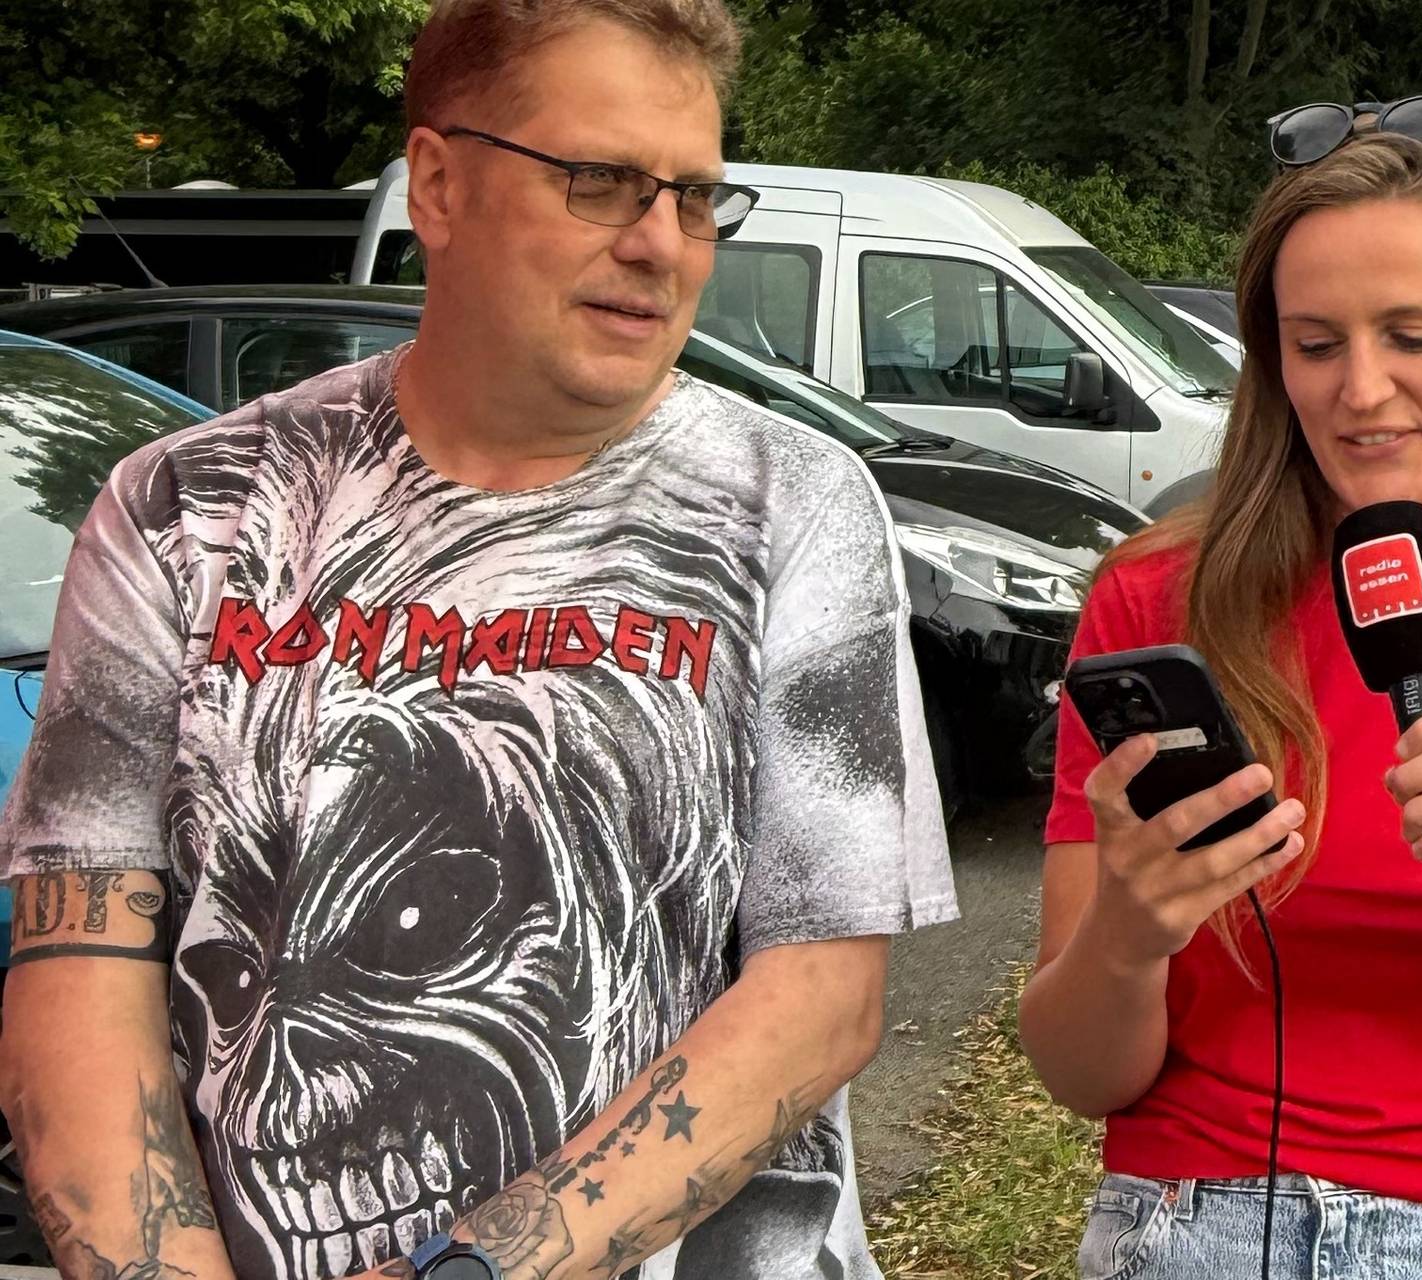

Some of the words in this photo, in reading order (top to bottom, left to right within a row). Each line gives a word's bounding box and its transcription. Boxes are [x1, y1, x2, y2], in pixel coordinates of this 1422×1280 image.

[1359, 559, 1402, 577] radio
[1359, 572, 1409, 592] essen
[402, 602, 718, 706] MAIDEN
